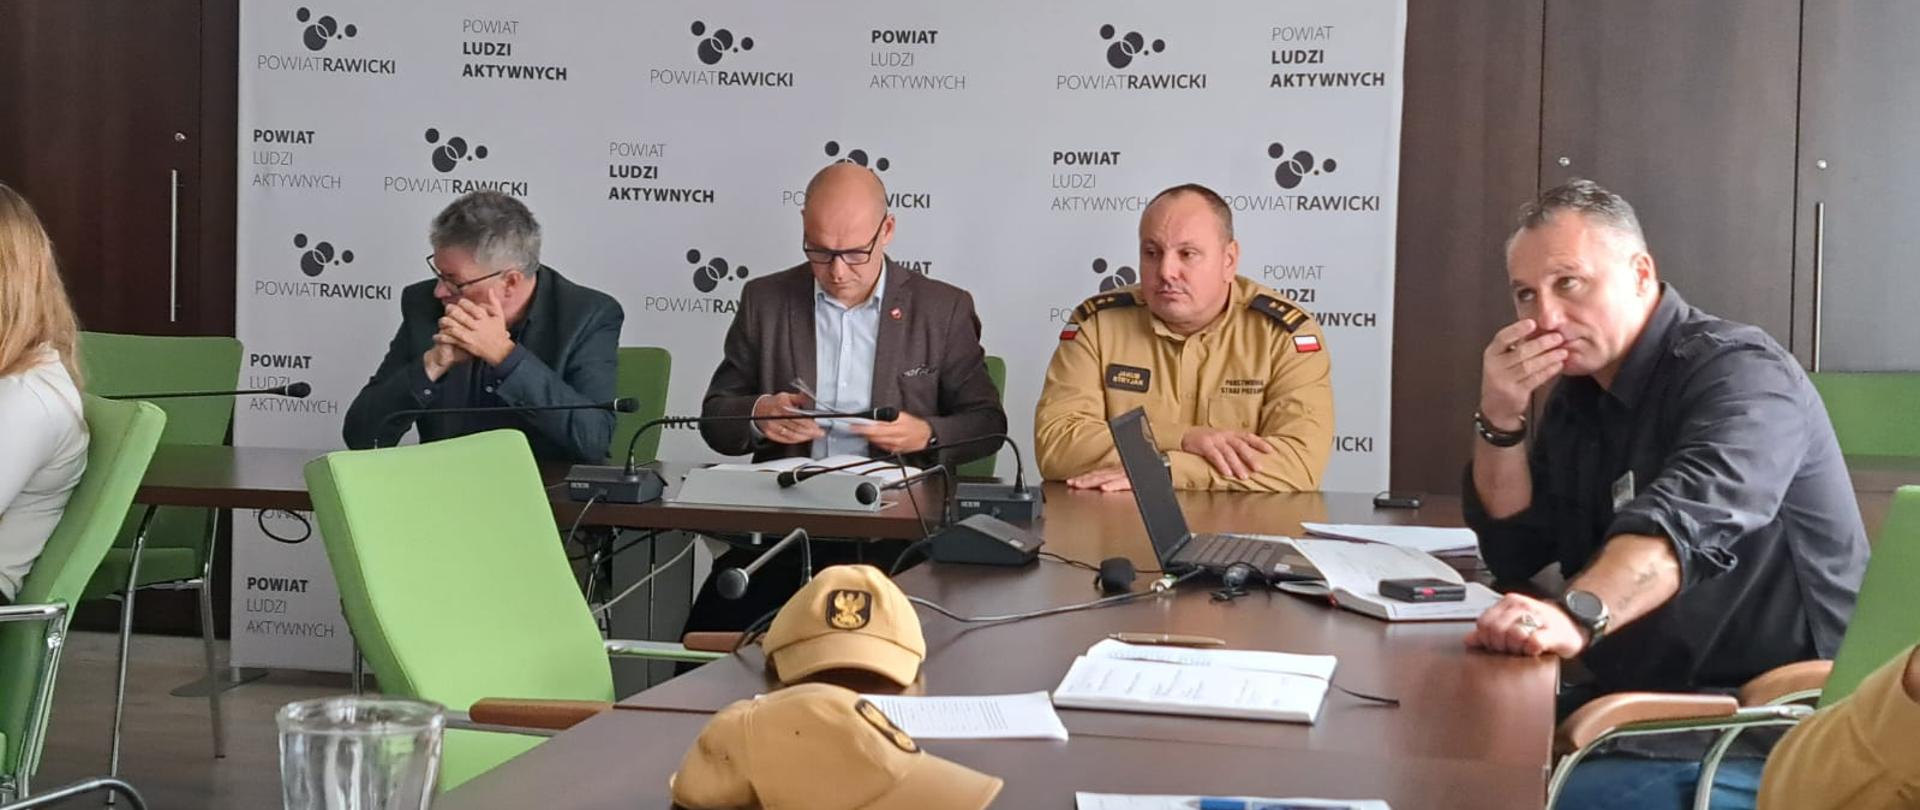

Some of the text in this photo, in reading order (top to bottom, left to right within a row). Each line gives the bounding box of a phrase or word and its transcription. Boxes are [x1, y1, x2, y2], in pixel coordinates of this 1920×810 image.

[462, 19, 519, 34] POWIAT
[1271, 25, 1335, 41] POWIAT
[871, 30, 938, 44] POWIAT
[462, 41, 512, 56] LUDZI
[1271, 49, 1324, 64] LUDZI
[257, 54, 396, 75] POWIATRAWICKI
[871, 51, 914, 67] LUDZI
[462, 63, 567, 81] AKTYWNYCH
[650, 69, 794, 87] POWIATRAWICKI
[1270, 72, 1385, 88] AKTYWNYCH
[869, 74, 966, 90] AKTYWNYCH
[1057, 74, 1207, 90] POWIATRAWICKI
[253, 129, 315, 144] POWIAT
[609, 141, 667, 158] POWIAT
[252, 151, 293, 166] LUDZI
[1052, 151, 1121, 166] POWIAT
[609, 164, 658, 179] LUDZI
[252, 173, 341, 189] AKTYWNYCH
[1052, 173, 1096, 189] LUDZI
[608, 187, 714, 203] AKTYWNYCH
[1051, 196, 1147, 211] AKTYWNYCH
[1263, 265, 1326, 280] POWIAT
[255, 280, 392, 300] POWIATRAWICKI
[645, 296, 740, 313] POWIATRA
[1312, 312, 1376, 327] WNYCH
[250, 354, 312, 369] POWIAT
[249, 397, 338, 414] AKTYWNYCH
[247, 577, 308, 592] POWIAT
[246, 598, 287, 613] LUDZI
[246, 620, 334, 638] AKTYWNYCH
